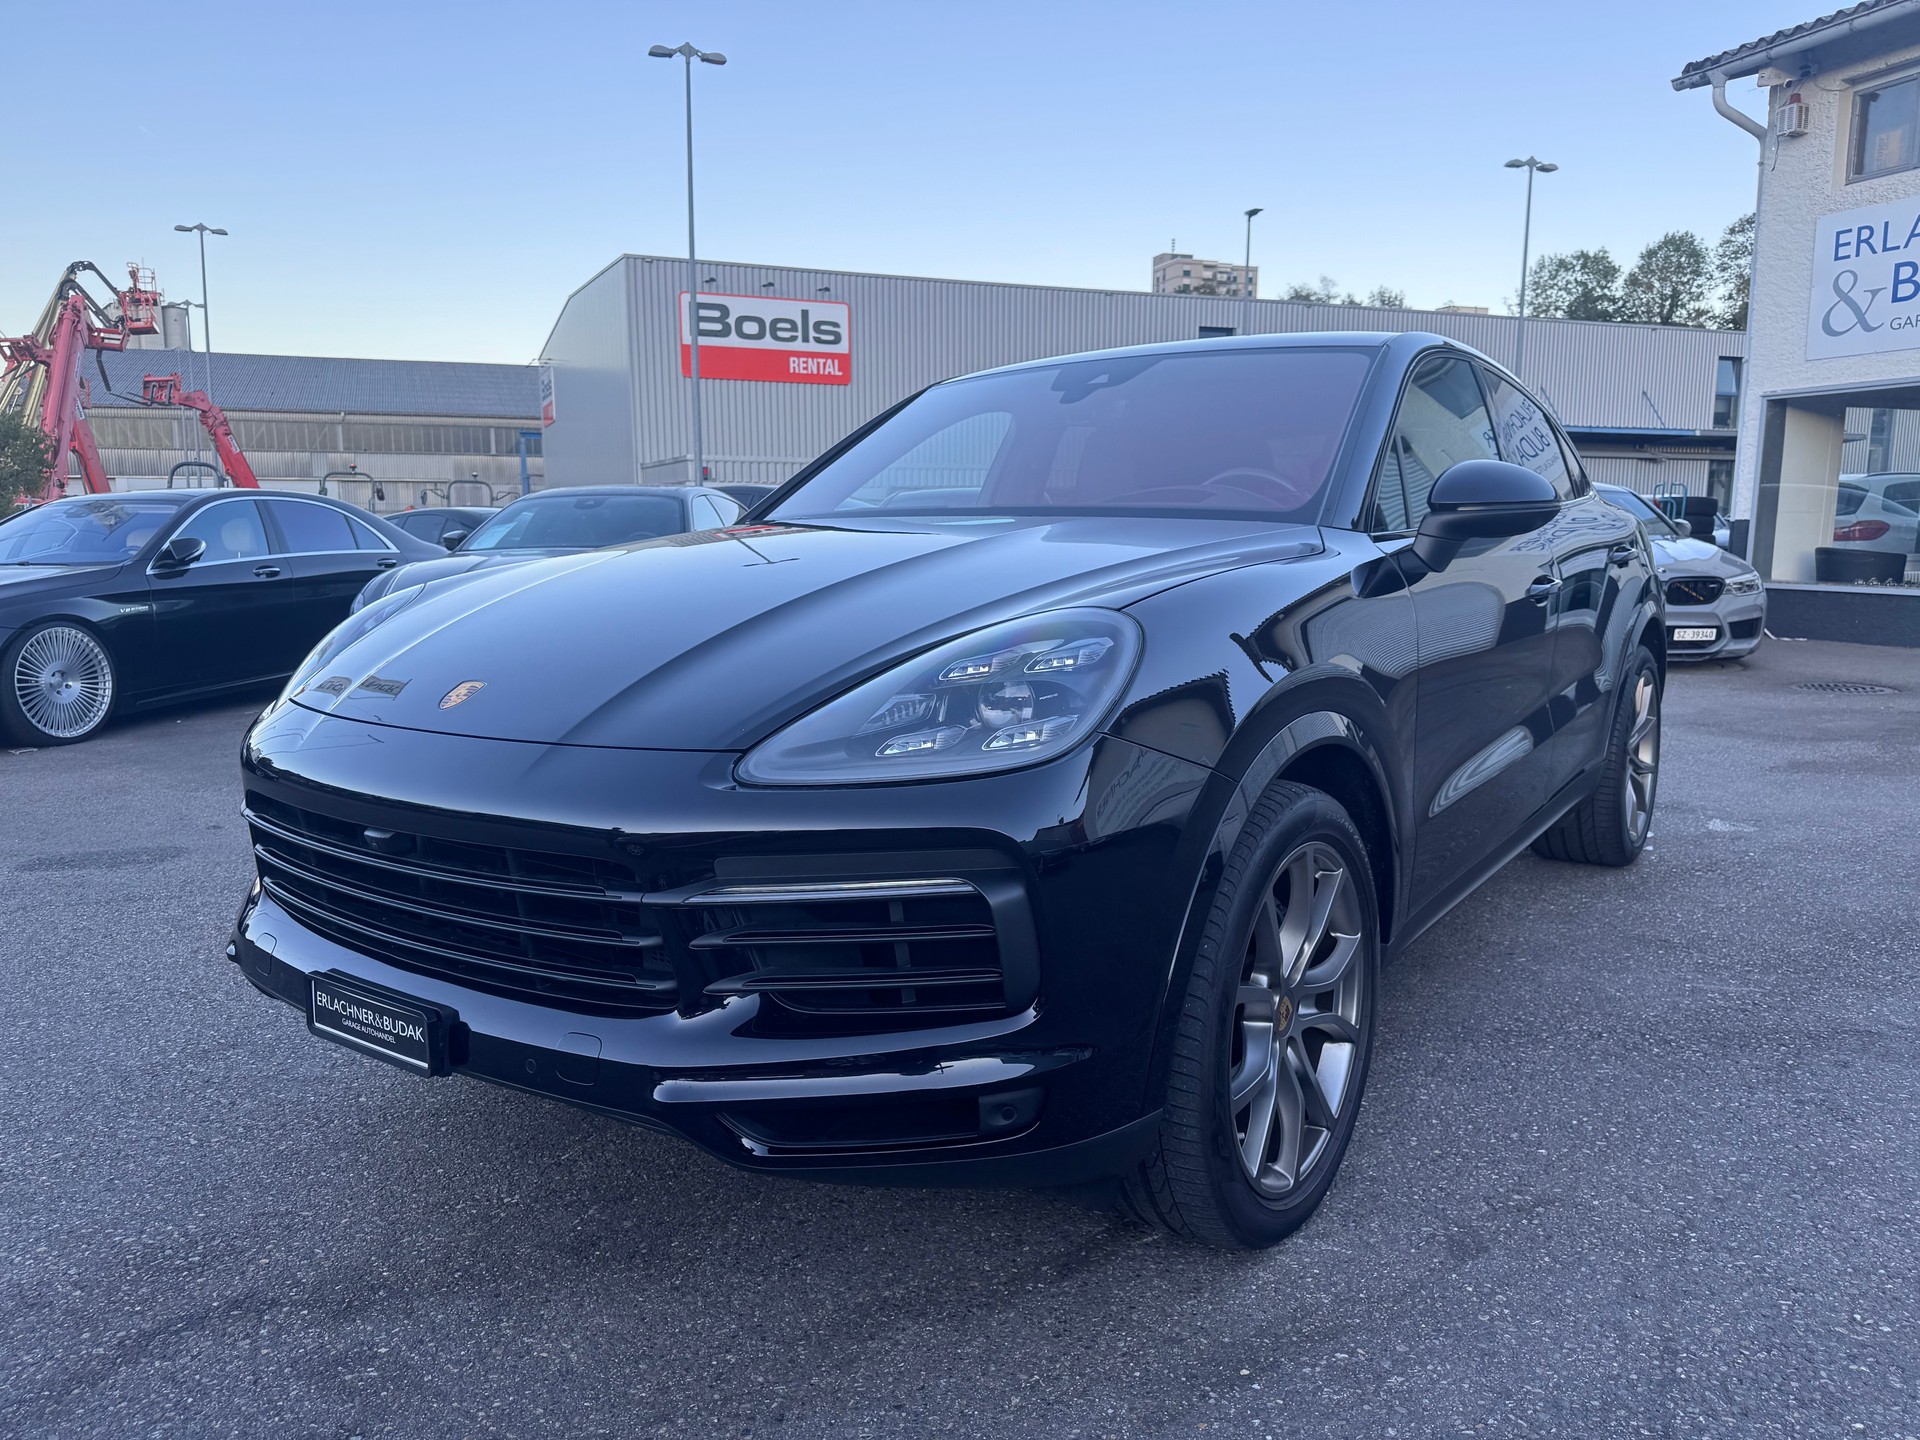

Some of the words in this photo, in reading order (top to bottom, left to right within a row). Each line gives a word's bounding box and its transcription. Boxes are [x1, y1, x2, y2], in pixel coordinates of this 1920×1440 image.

[689, 301, 842, 345] Boels
[1821, 269, 1888, 338] &
[789, 356, 843, 376] RENTAL
